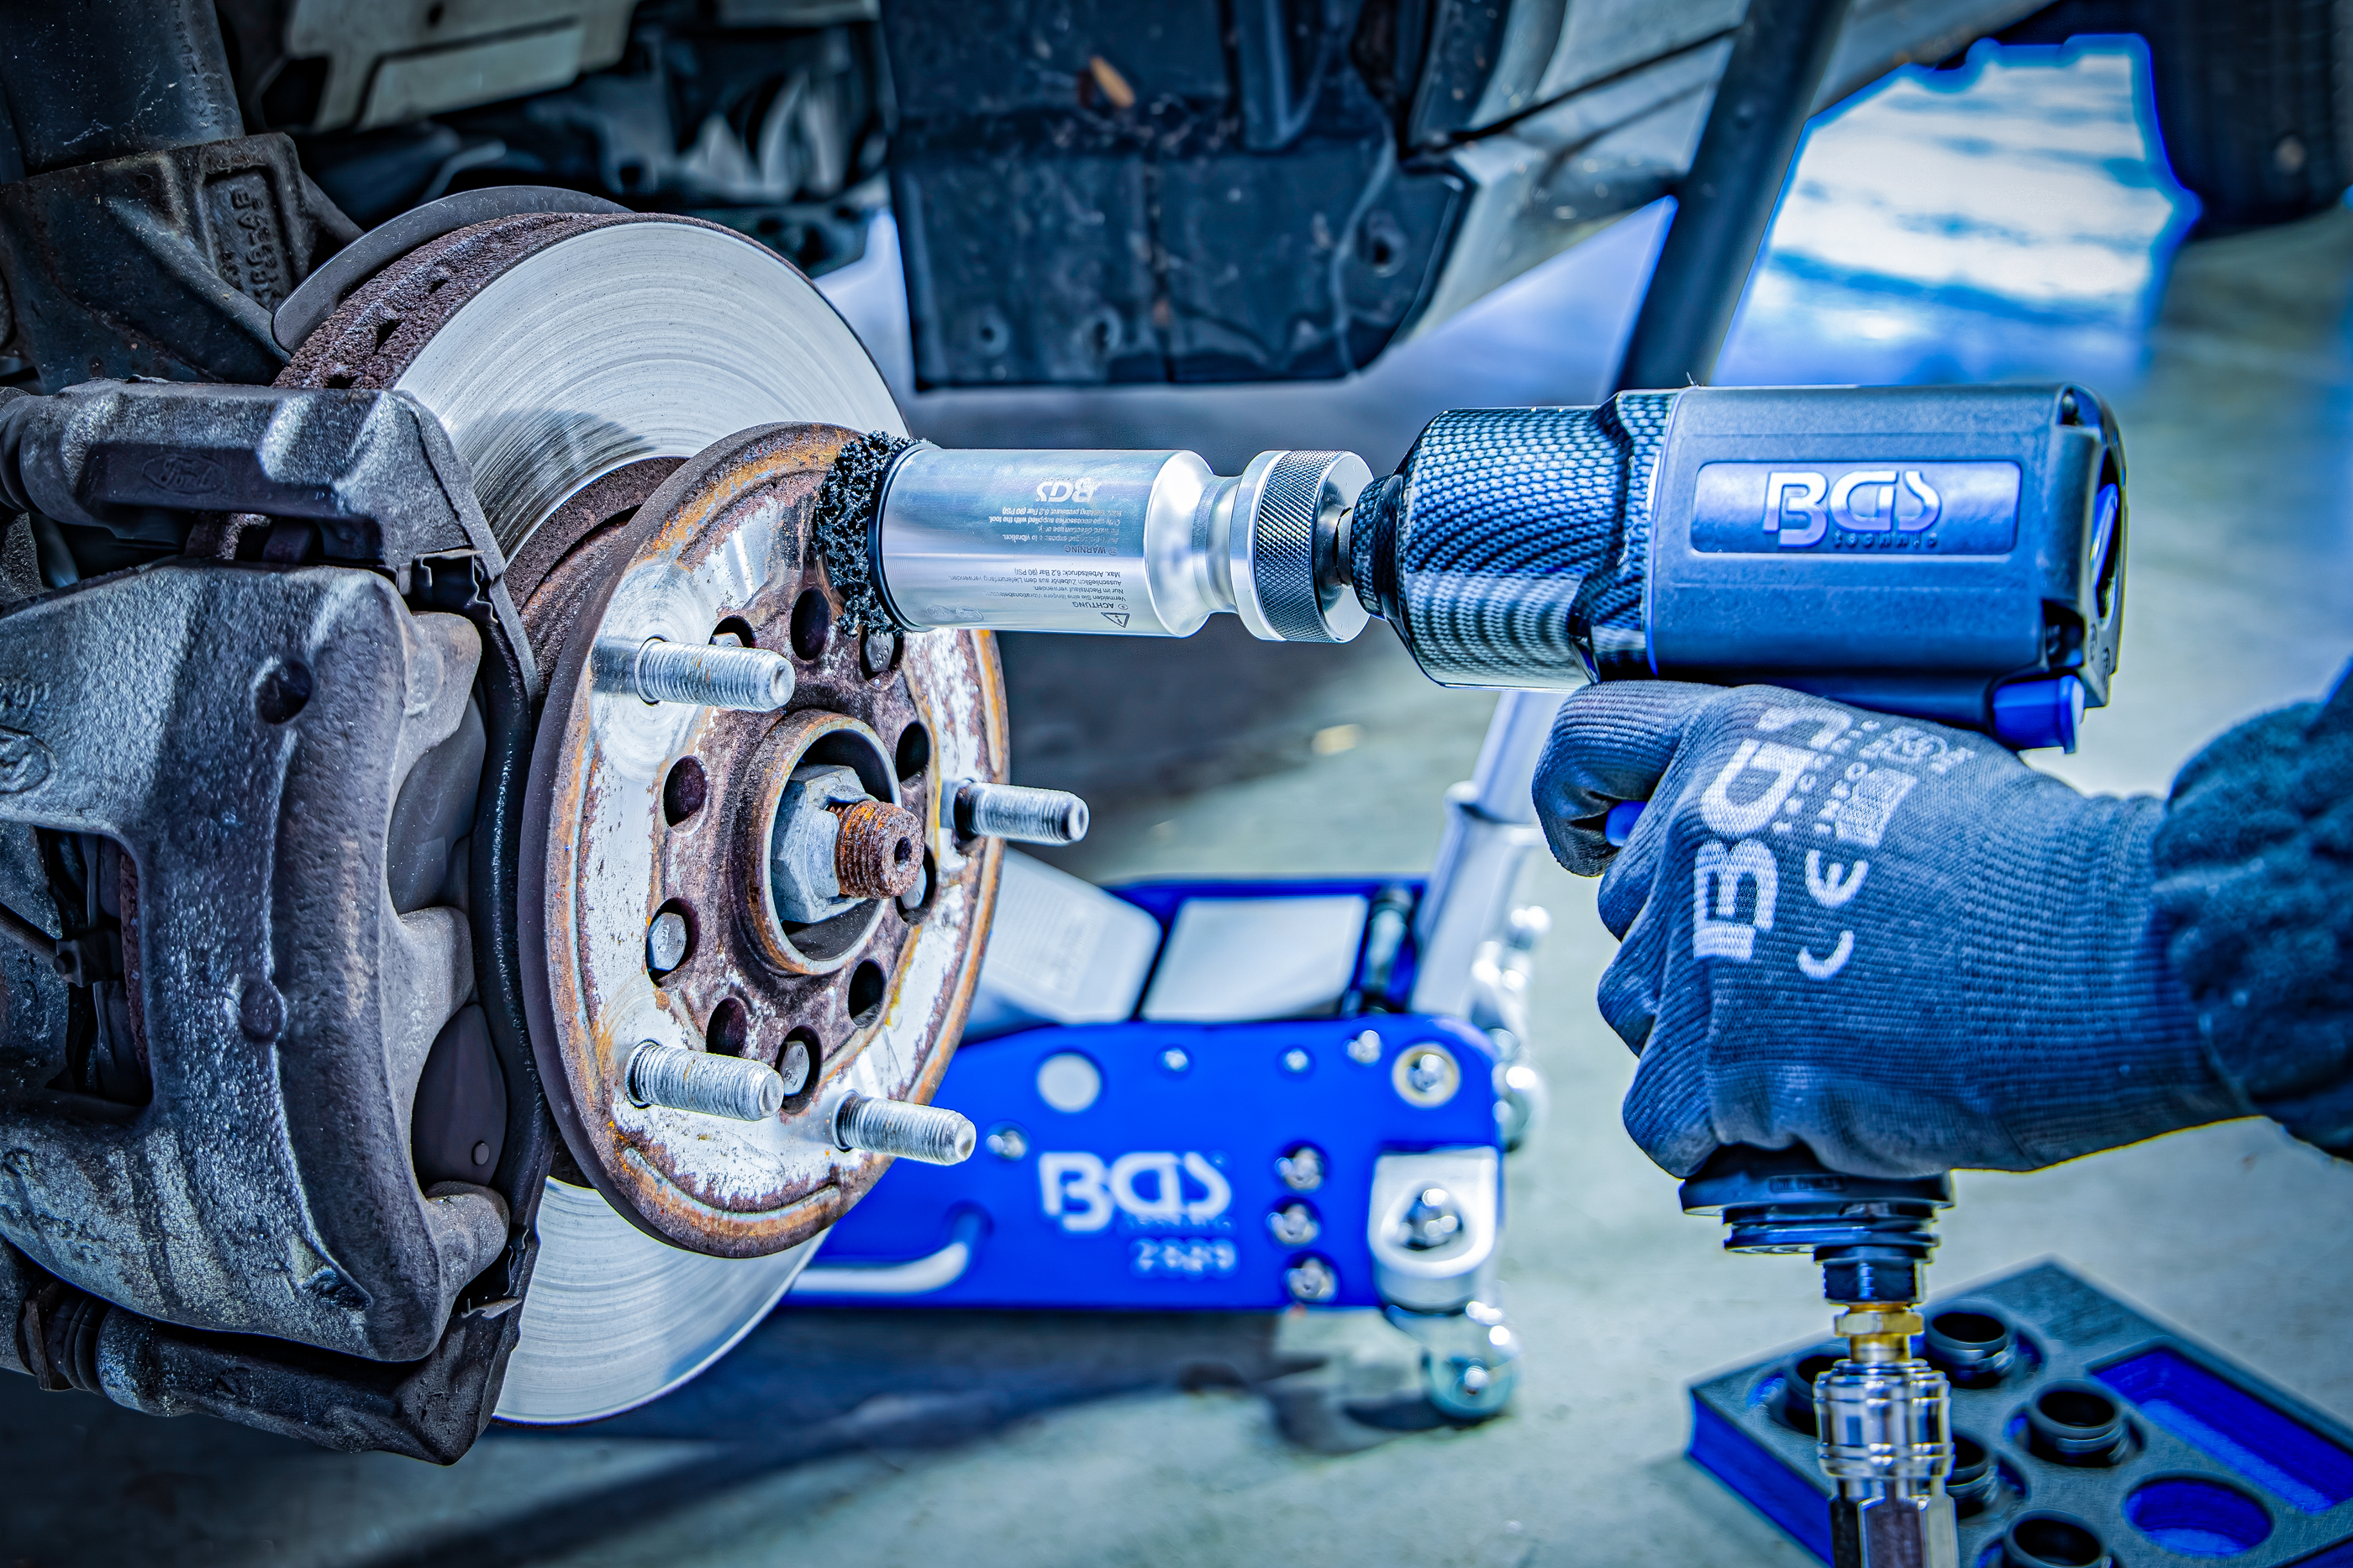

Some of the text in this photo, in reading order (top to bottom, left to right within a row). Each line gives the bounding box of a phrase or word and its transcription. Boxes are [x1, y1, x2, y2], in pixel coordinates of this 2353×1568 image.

[1037, 478, 1098, 502] BGS
[1003, 507, 1015, 515] PSI)
[1017, 507, 1026, 515] (90
[1028, 516, 1055, 524] supplied
[1761, 470, 1942, 547] BGS
[1003, 534, 1030, 542] vibration.
[1693, 707, 1854, 961] BGS
[1798, 849, 1869, 981] CE
[1038, 1150, 1232, 1232] BGS
